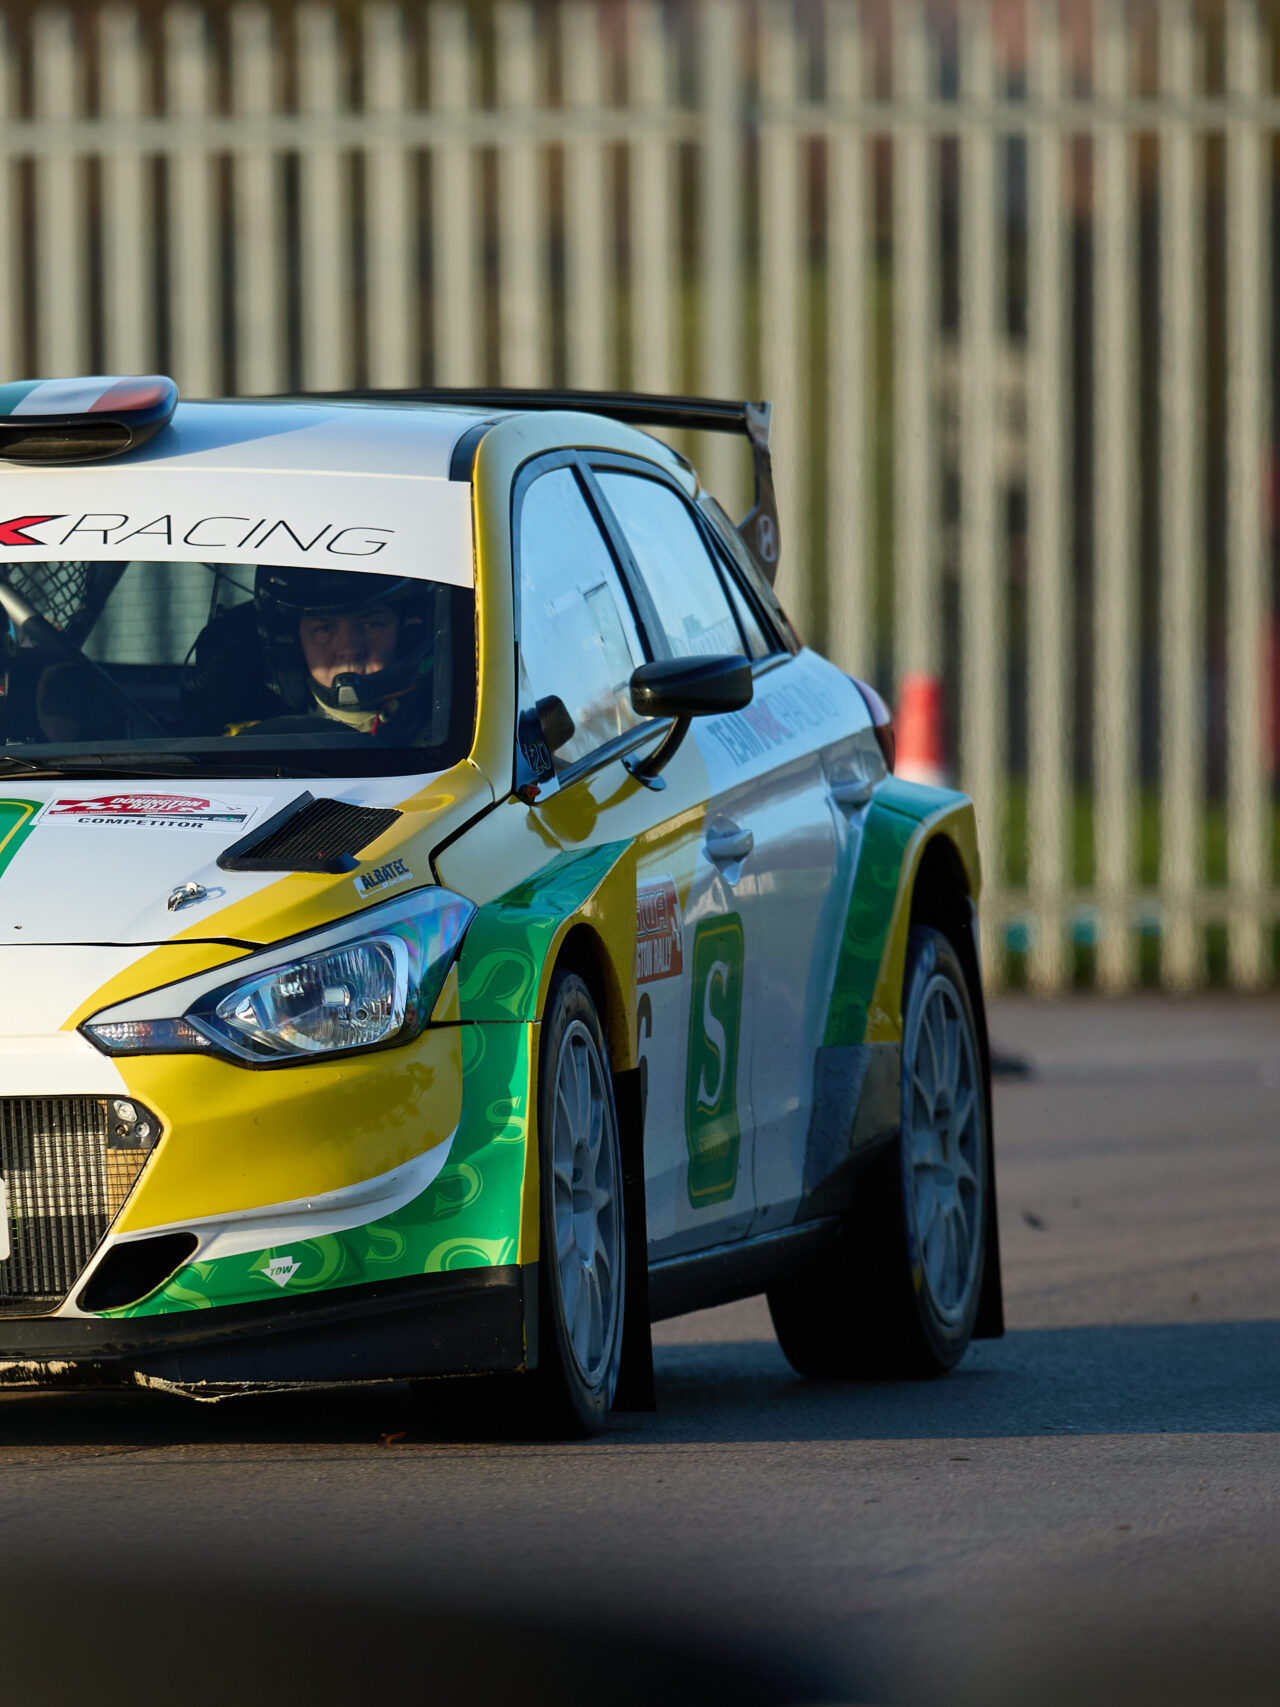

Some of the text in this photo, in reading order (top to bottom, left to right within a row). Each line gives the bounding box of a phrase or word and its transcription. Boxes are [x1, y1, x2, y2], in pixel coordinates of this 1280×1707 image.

[59, 514, 395, 556] RACING
[77, 817, 204, 829] COMPETITOR
[270, 1264, 294, 1277] TOW
